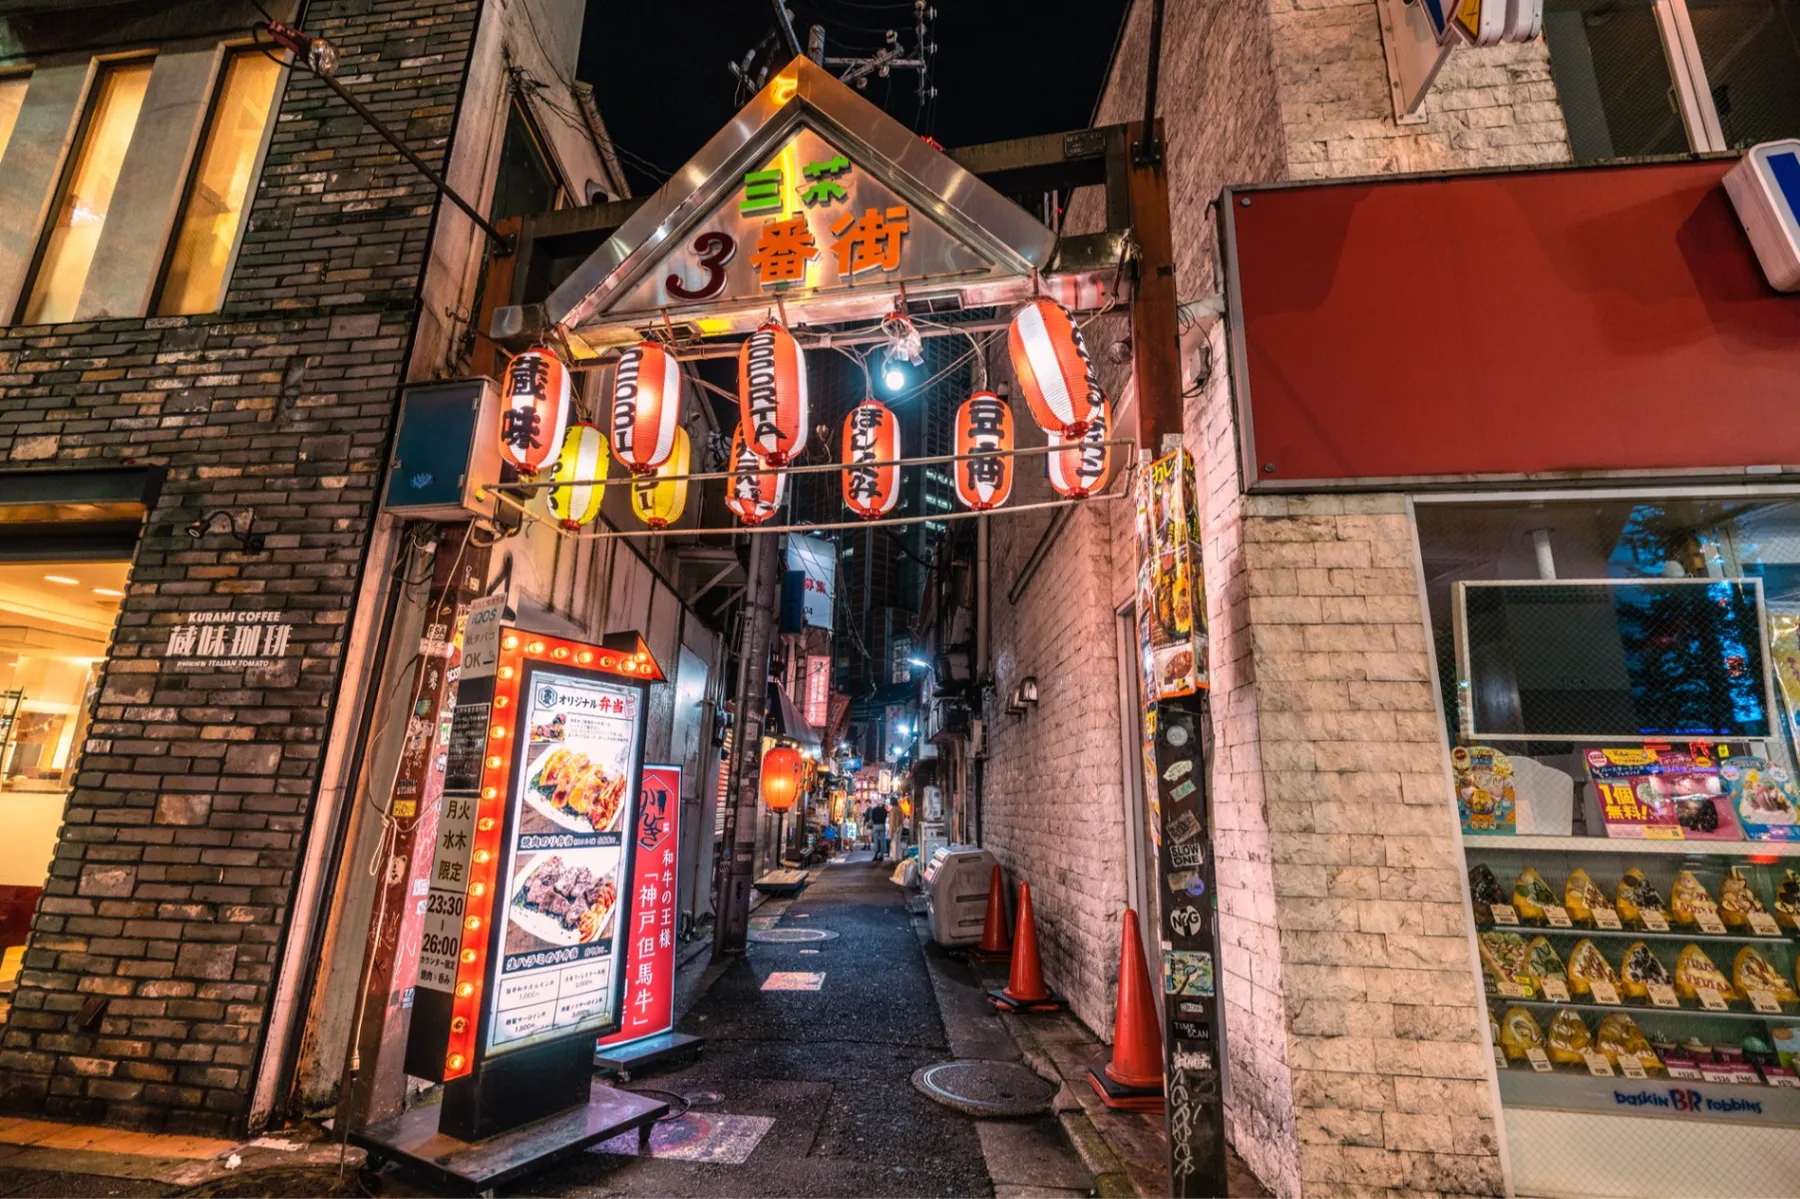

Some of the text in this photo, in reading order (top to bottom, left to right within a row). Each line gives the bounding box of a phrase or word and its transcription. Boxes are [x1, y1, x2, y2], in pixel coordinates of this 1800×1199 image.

[739, 155, 852, 217] 三茶
[502, 356, 552, 449] 蔵味
[189, 611, 281, 623] KURAMI COFFEE
[164, 625, 293, 657] 蔵味珈琲
[464, 652, 481, 669] OK
[558, 694, 625, 714] オリジナル 弁当
[1598, 783, 1636, 805] 1個
[447, 800, 471, 820] 月火
[443, 830, 467, 851] 水木
[1171, 845, 1199, 857] SLOW
[1173, 856, 1200, 865] ONE
[438, 860, 464, 883] 限定
[428, 894, 464, 917] 23:30
[657, 849, 674, 950] 和牛の王様
[422, 934, 459, 958] 26:00
[633, 872, 659, 1026] 「神戸但馬牛」
[420, 956, 456, 971] カウンター限定
[1173, 1021, 1195, 1030] TIME
[1186, 1028, 1209, 1039] SCAN
[1613, 1088, 1762, 1114] baskin BR robbins
